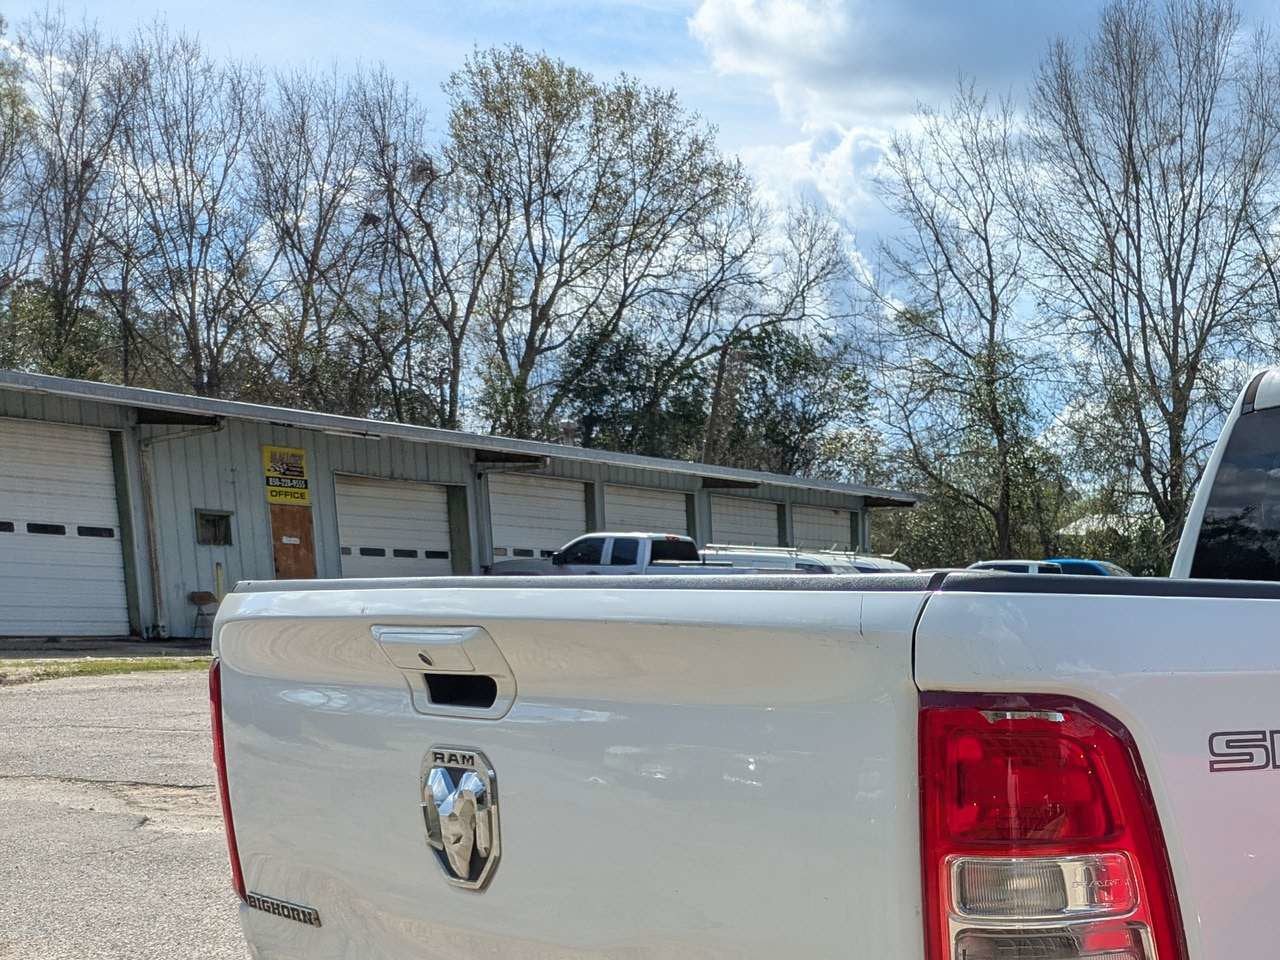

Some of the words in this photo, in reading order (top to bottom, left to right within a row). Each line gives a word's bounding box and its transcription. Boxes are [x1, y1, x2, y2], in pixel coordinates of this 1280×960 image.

[270, 489, 306, 500] OFFICE
[432, 752, 475, 766] RAM
[247, 895, 315, 926] BIGHORN
